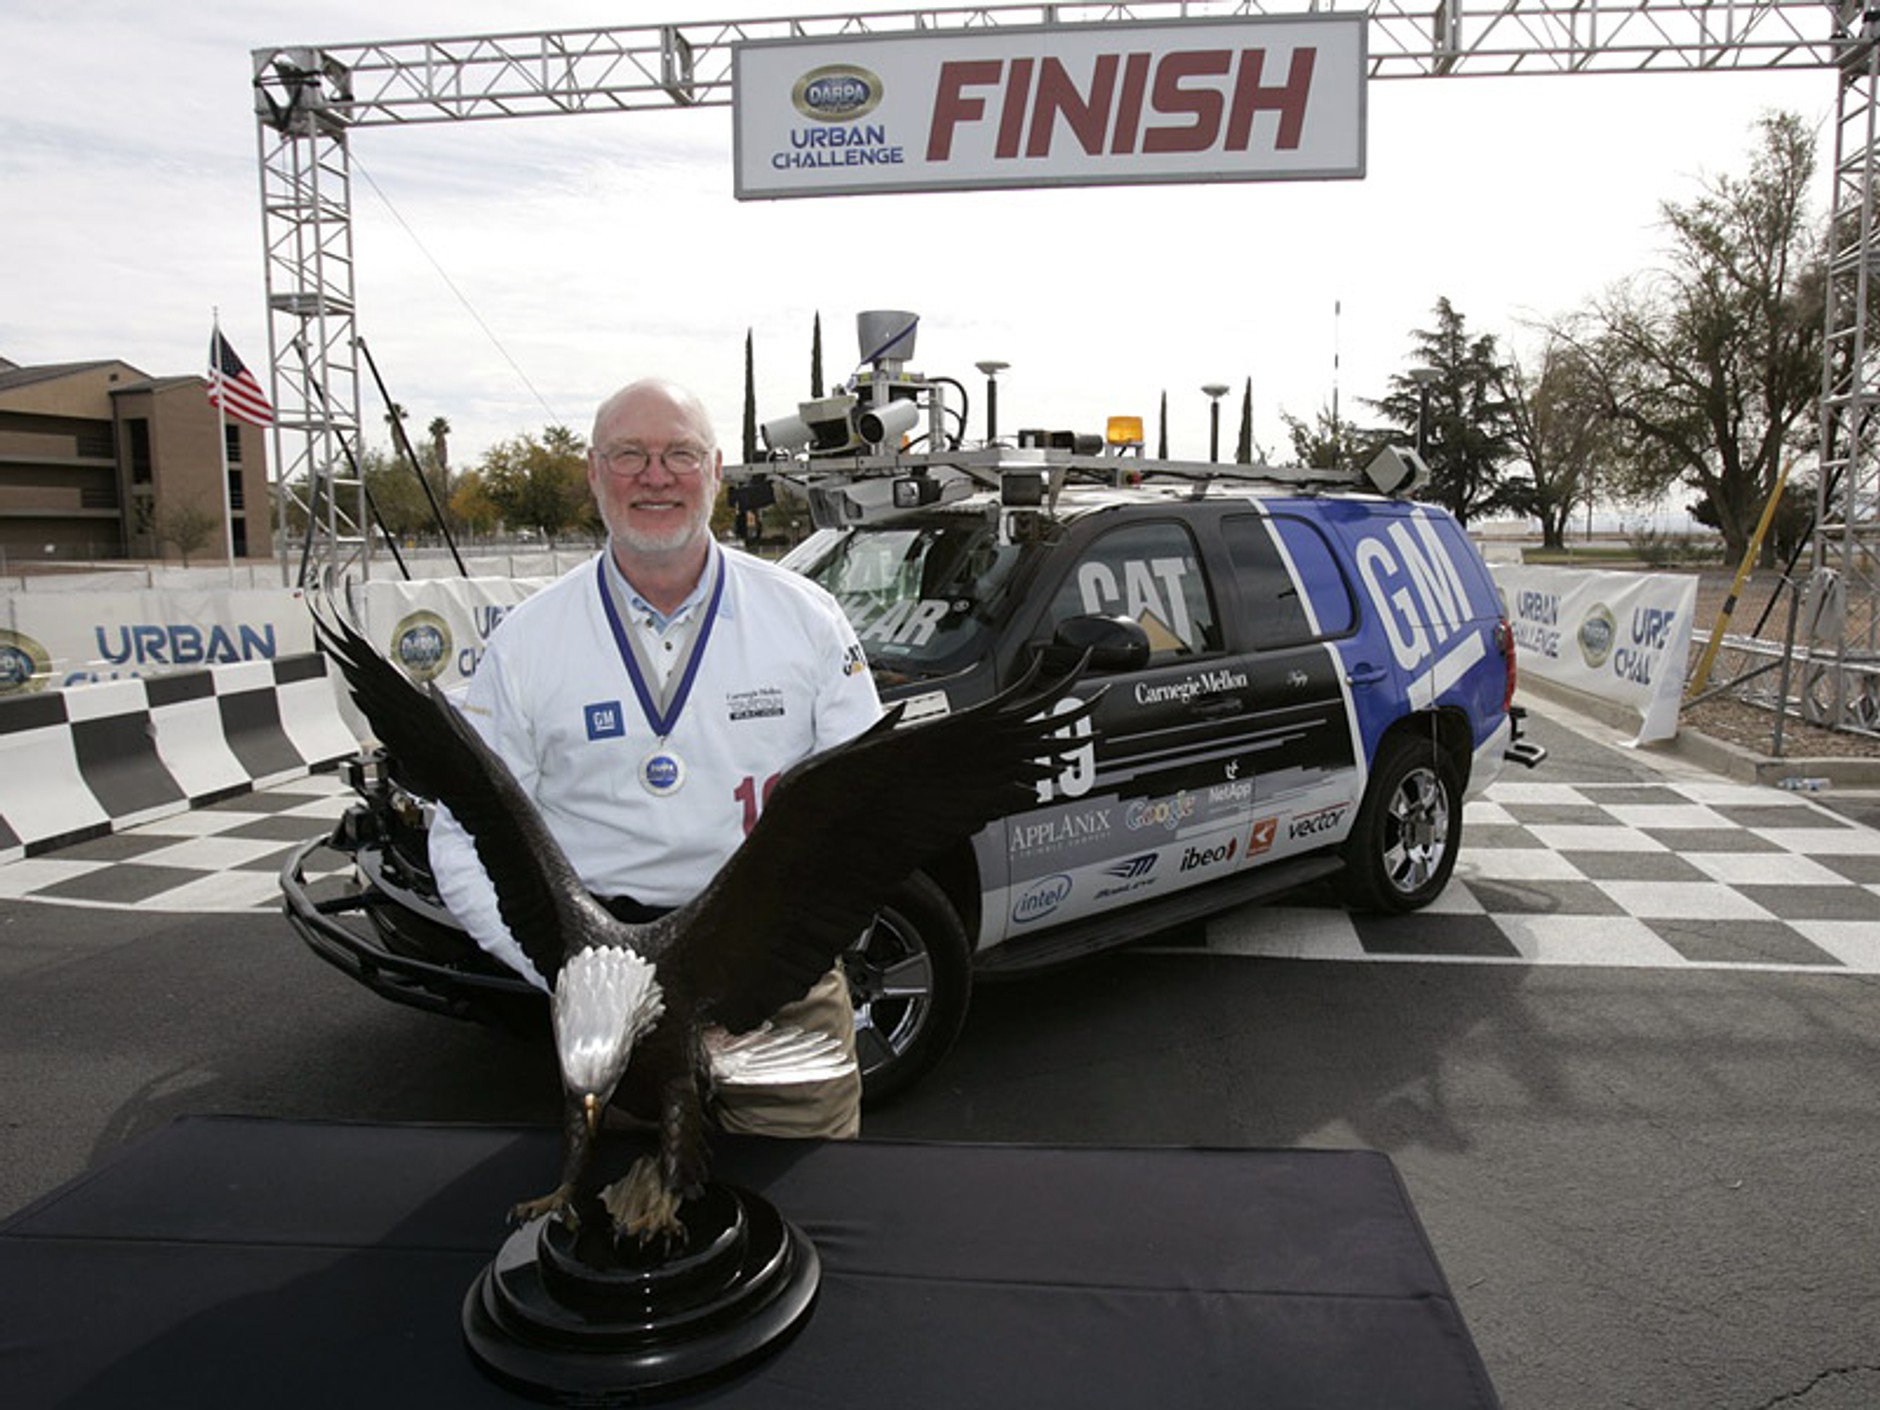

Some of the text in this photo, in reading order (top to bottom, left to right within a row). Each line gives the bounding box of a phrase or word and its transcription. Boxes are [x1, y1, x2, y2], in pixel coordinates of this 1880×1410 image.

[808, 82, 866, 106] DARPA
[925, 47, 1318, 162] FINISH
[791, 125, 885, 149] URBAN
[771, 146, 904, 170] CHALLENGE
[1078, 556, 1193, 648] CAT
[1356, 507, 1475, 671] GM
[1517, 590, 1561, 626] URBAN
[95, 622, 276, 665] URBAN
[1135, 669, 1248, 704] Carnegie Mellon
[1207, 782, 1252, 803] NetApp
[1126, 789, 1196, 831] Google
[1288, 808, 1346, 841] vector
[1179, 843, 1227, 873] ibeo
[1019, 883, 1064, 912] intel
